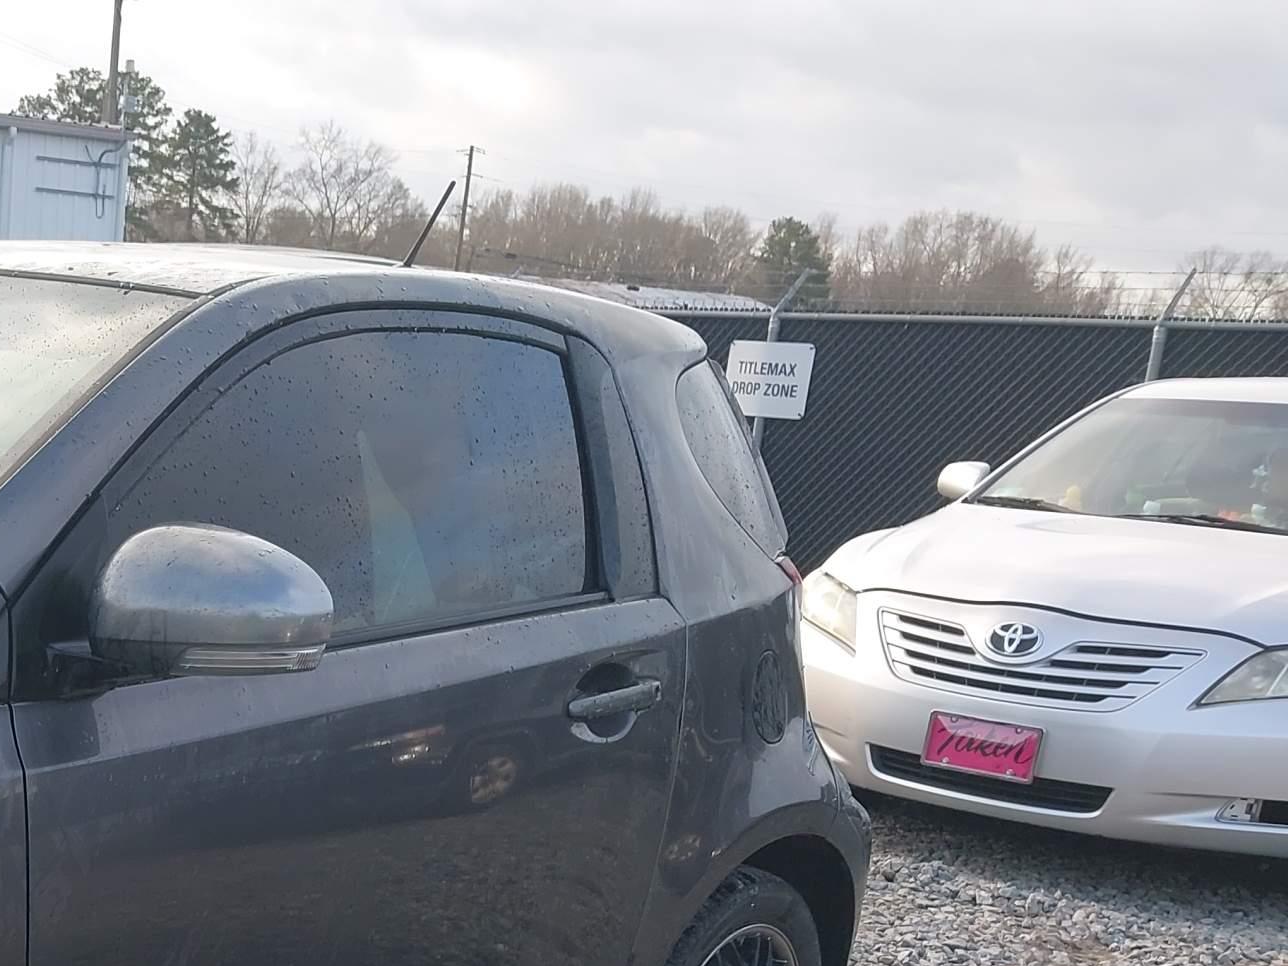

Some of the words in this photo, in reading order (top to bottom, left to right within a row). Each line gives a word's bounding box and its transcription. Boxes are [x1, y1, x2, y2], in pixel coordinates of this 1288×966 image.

[739, 360, 798, 377] TITLEMAX
[732, 381, 761, 395] DROP
[763, 383, 799, 398] ZONE
